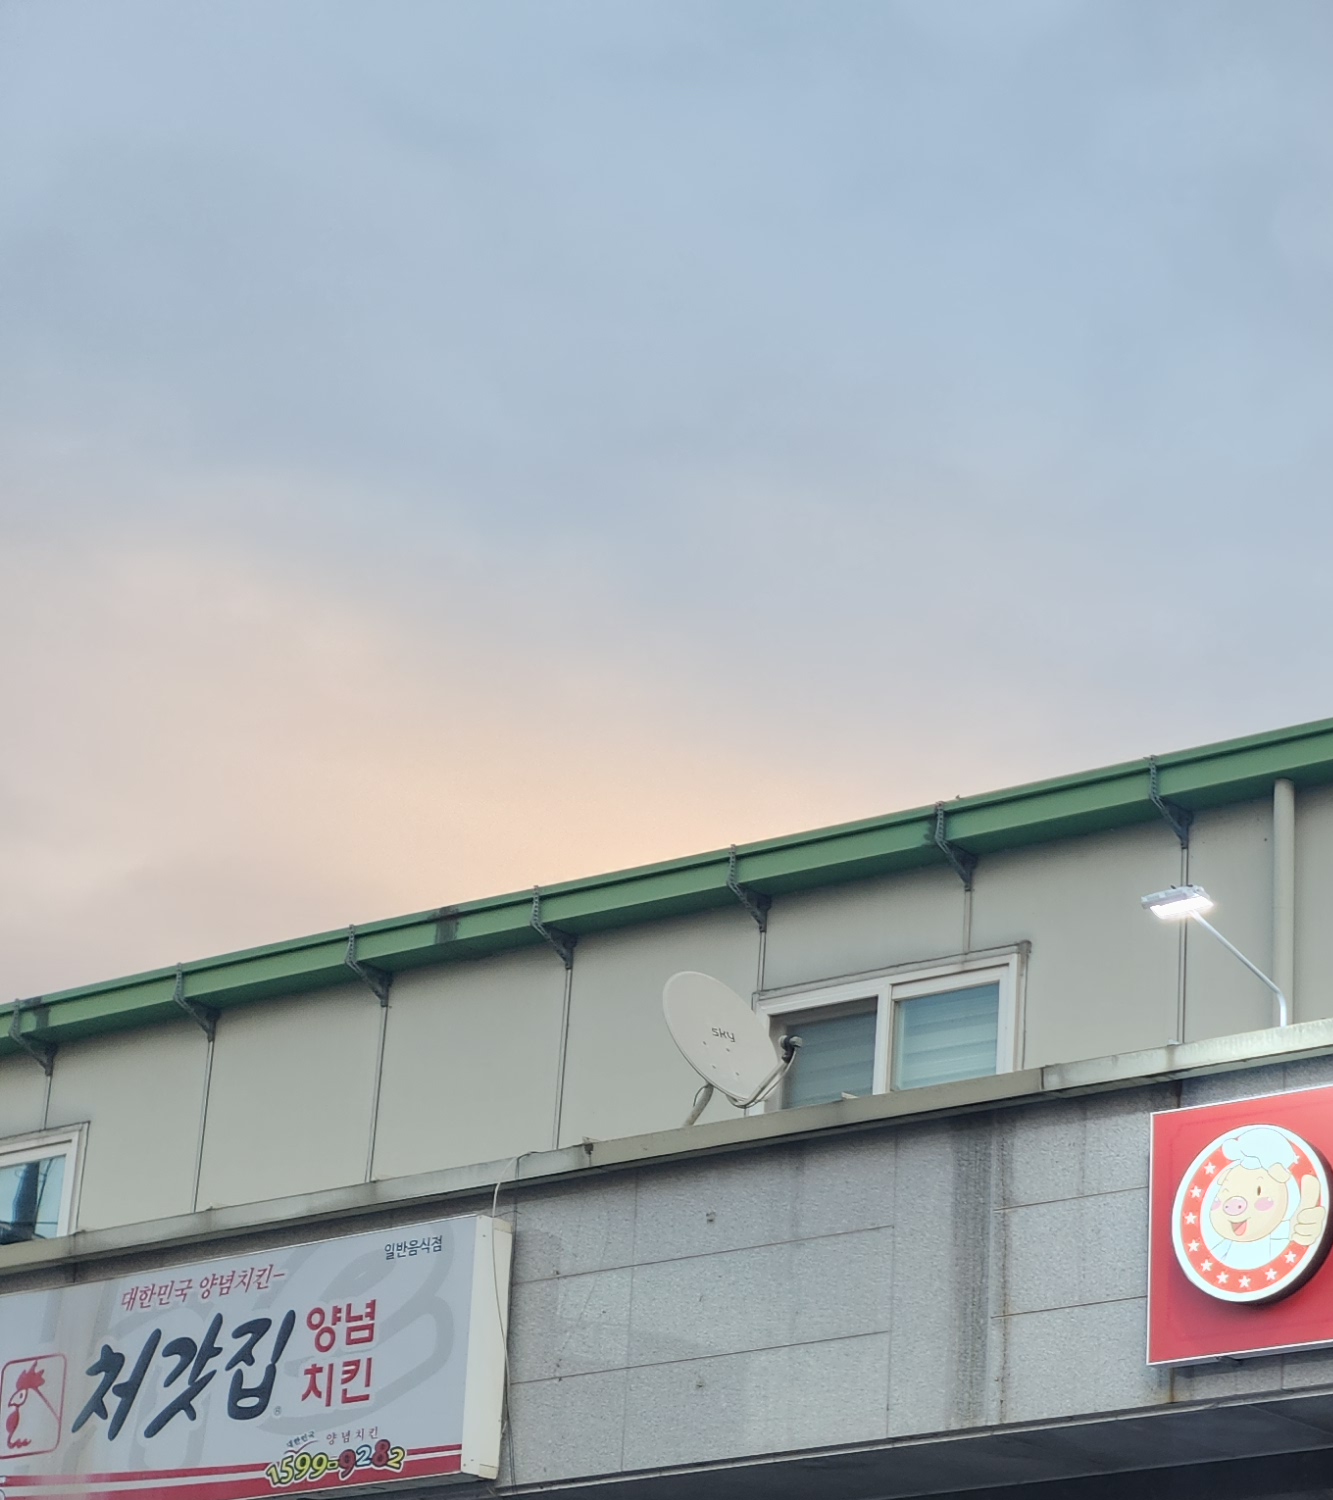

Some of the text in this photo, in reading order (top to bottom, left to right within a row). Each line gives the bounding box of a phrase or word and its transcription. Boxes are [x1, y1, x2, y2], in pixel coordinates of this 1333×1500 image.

[384, 1235, 443, 1261] 일반음식점
[121, 1277, 193, 1311] 대한민국
[306, 1300, 377, 1352] 양념
[72, 1309, 296, 1441] 처갓집
[301, 1357, 373, 1407] 치킨
[267, 1439, 406, 1486] 1599-9282
